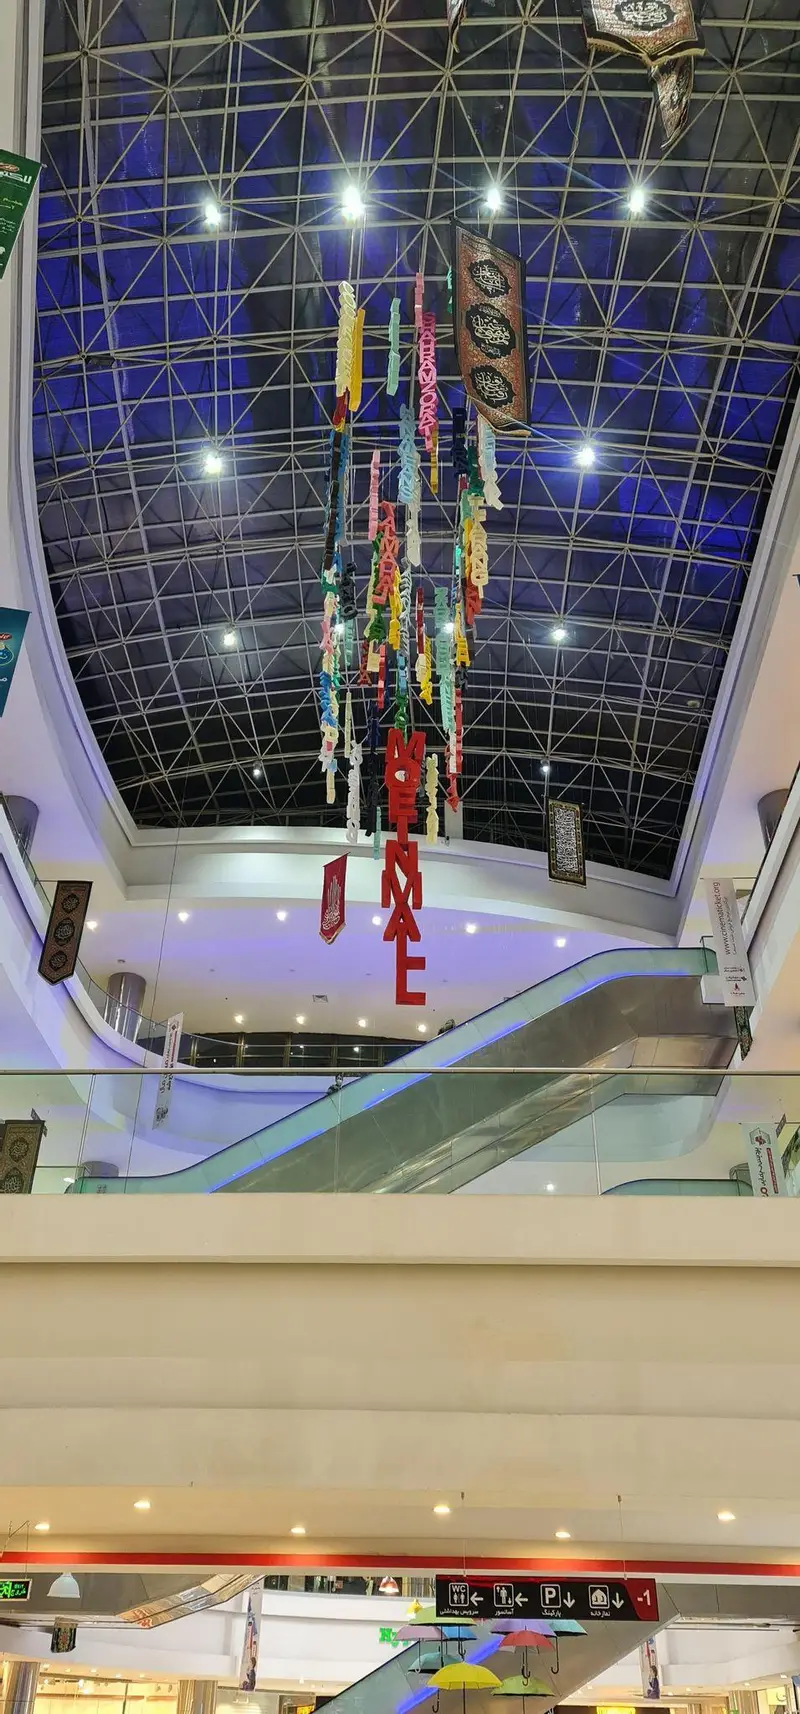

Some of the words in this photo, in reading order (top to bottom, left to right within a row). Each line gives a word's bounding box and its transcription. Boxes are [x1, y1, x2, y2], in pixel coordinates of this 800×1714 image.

[713, 882, 731, 956] www.cinematicket.org
[451, 1585, 466, 1593] WC
[544, 1587, 557, 1605] P
[637, 1589, 652, 1606] -1
[440, 1608, 460, 1616] بهداشتی
[494, 1608, 515, 1616] آسانسور
[541, 1608, 562, 1618] پارکینگ
